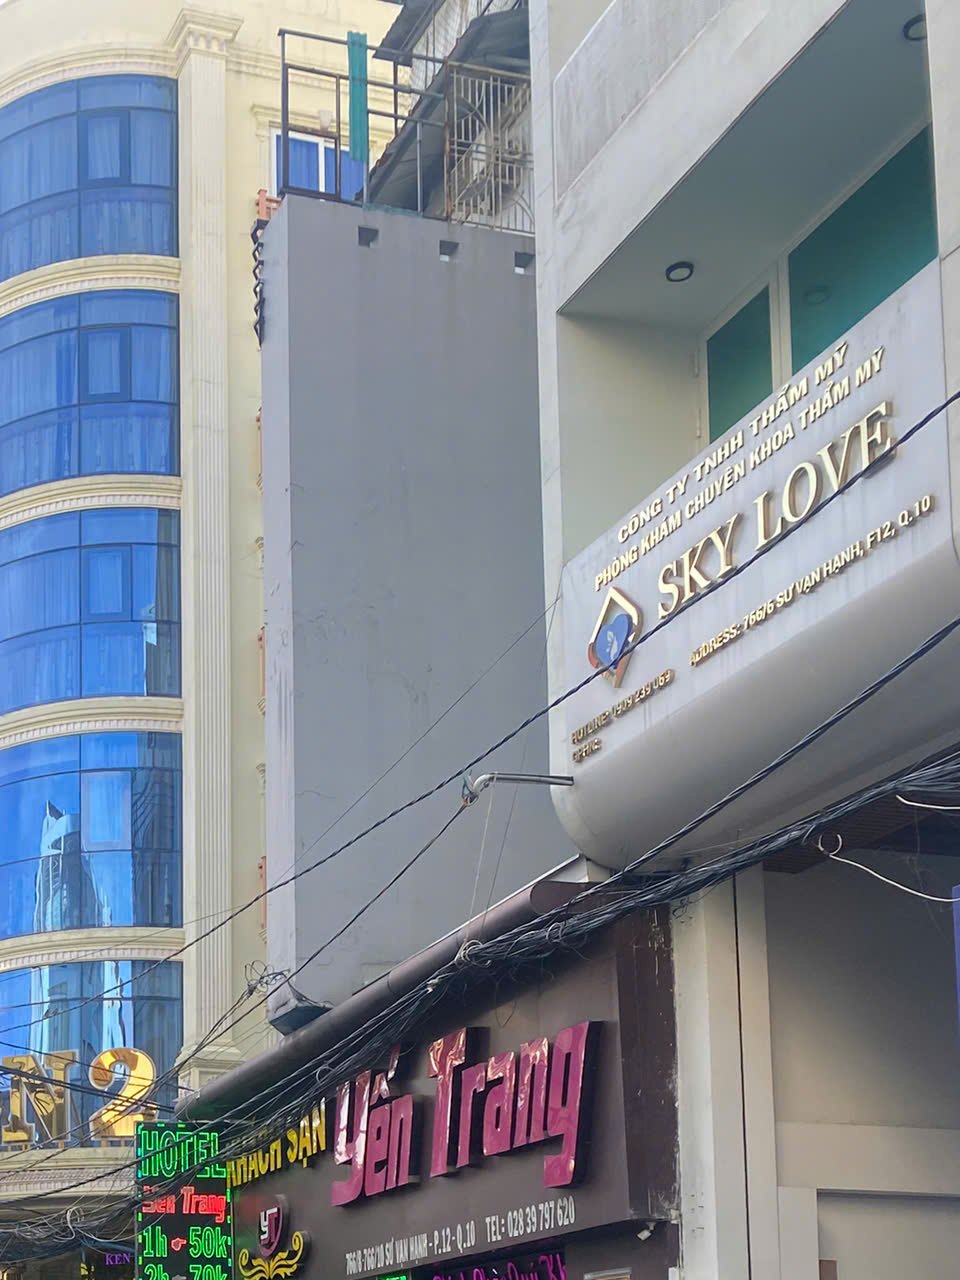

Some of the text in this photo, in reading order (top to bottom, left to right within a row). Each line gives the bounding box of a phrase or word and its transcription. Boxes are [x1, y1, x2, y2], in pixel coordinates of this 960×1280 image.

[617, 498, 663, 544] CÔNG
[666, 475, 690, 505] TY
[693, 430, 745, 482] TNHH
[815, 341, 849, 386] MỸ
[595, 545, 640, 592] PHÒNG
[640, 510, 683, 556] KHÁM
[686, 461, 746, 520] CHUYÊN
[750, 423, 796, 471] KHOA
[656, 400, 897, 622] SKY LOVE
[796, 567, 821, 594] VẠN
[89, 1047, 157, 1139] 2
[331, 1020, 592, 1207] Yến Trang
[141, 1130, 227, 1178] HOTEL
[180, 1186, 227, 1223] Trang
[485, 1215, 505, 1242] TEL:
[507, 1210, 524, 1238] 028
[525, 1207, 538, 1234] 39
[539, 1201, 556, 1230] 797
[557, 1195, 576, 1226] 620
[105, 1253, 132, 1265] KEN
[143, 1226, 228, 1258] 1h 50k
